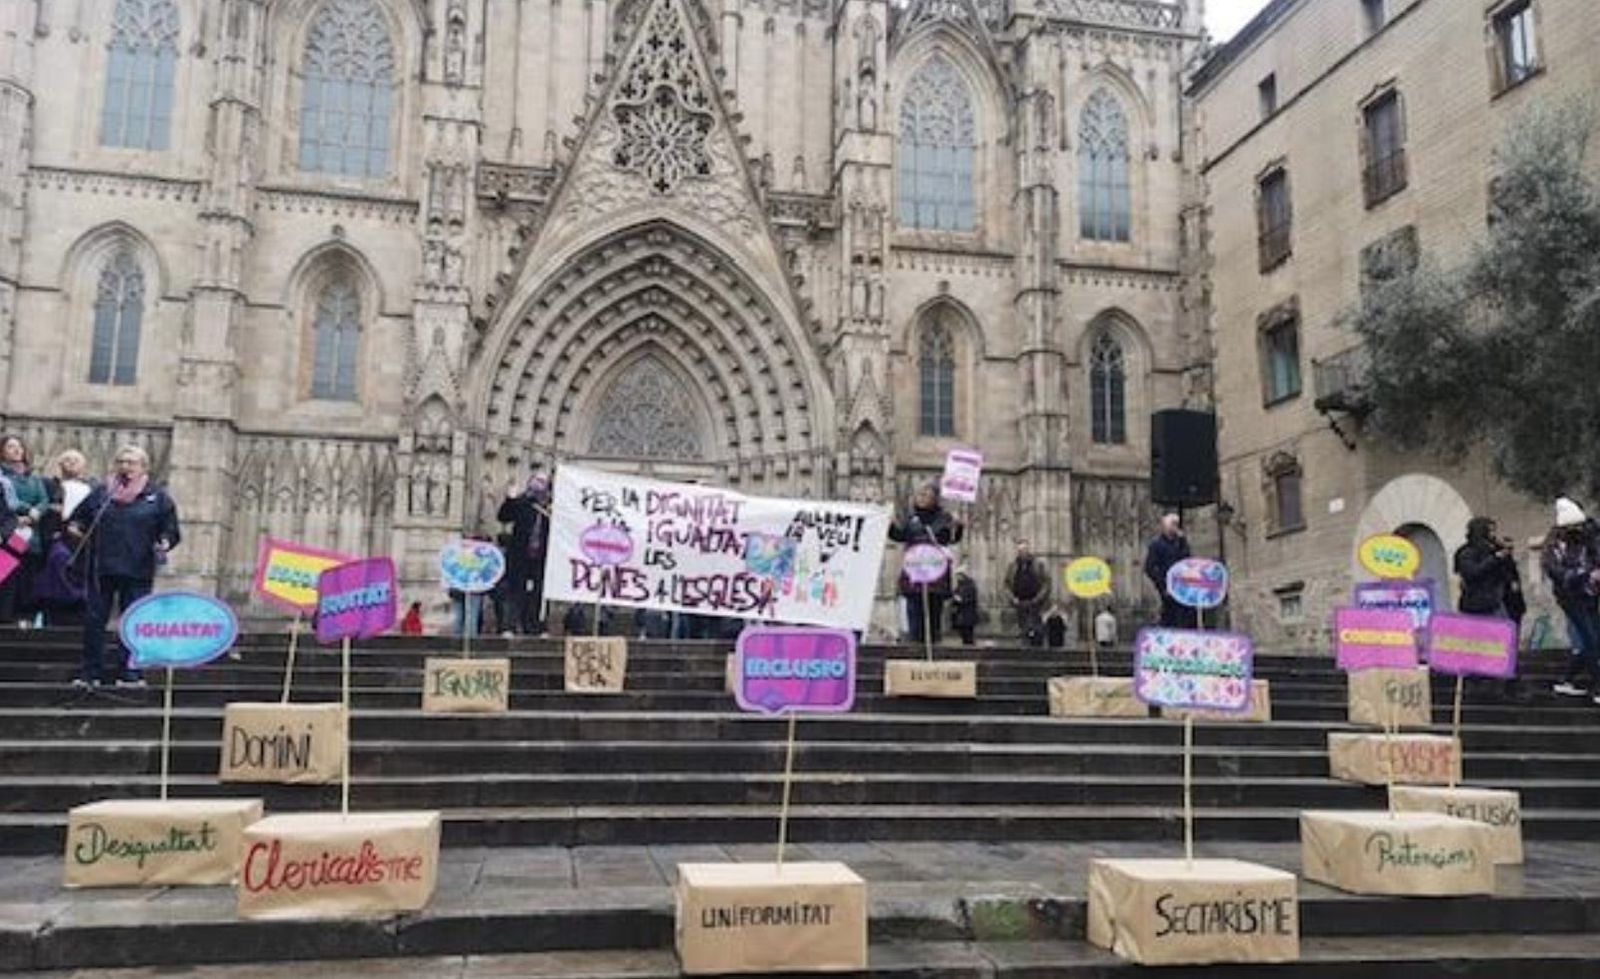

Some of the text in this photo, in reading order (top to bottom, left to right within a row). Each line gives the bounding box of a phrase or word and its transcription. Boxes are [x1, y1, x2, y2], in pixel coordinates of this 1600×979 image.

[646, 490, 746, 524] DIGNITAT
[135, 622, 223, 638] IGUALTAT
[745, 652, 847, 678] INCLUSIÓ
[74, 822, 218, 869] Desigualtat
